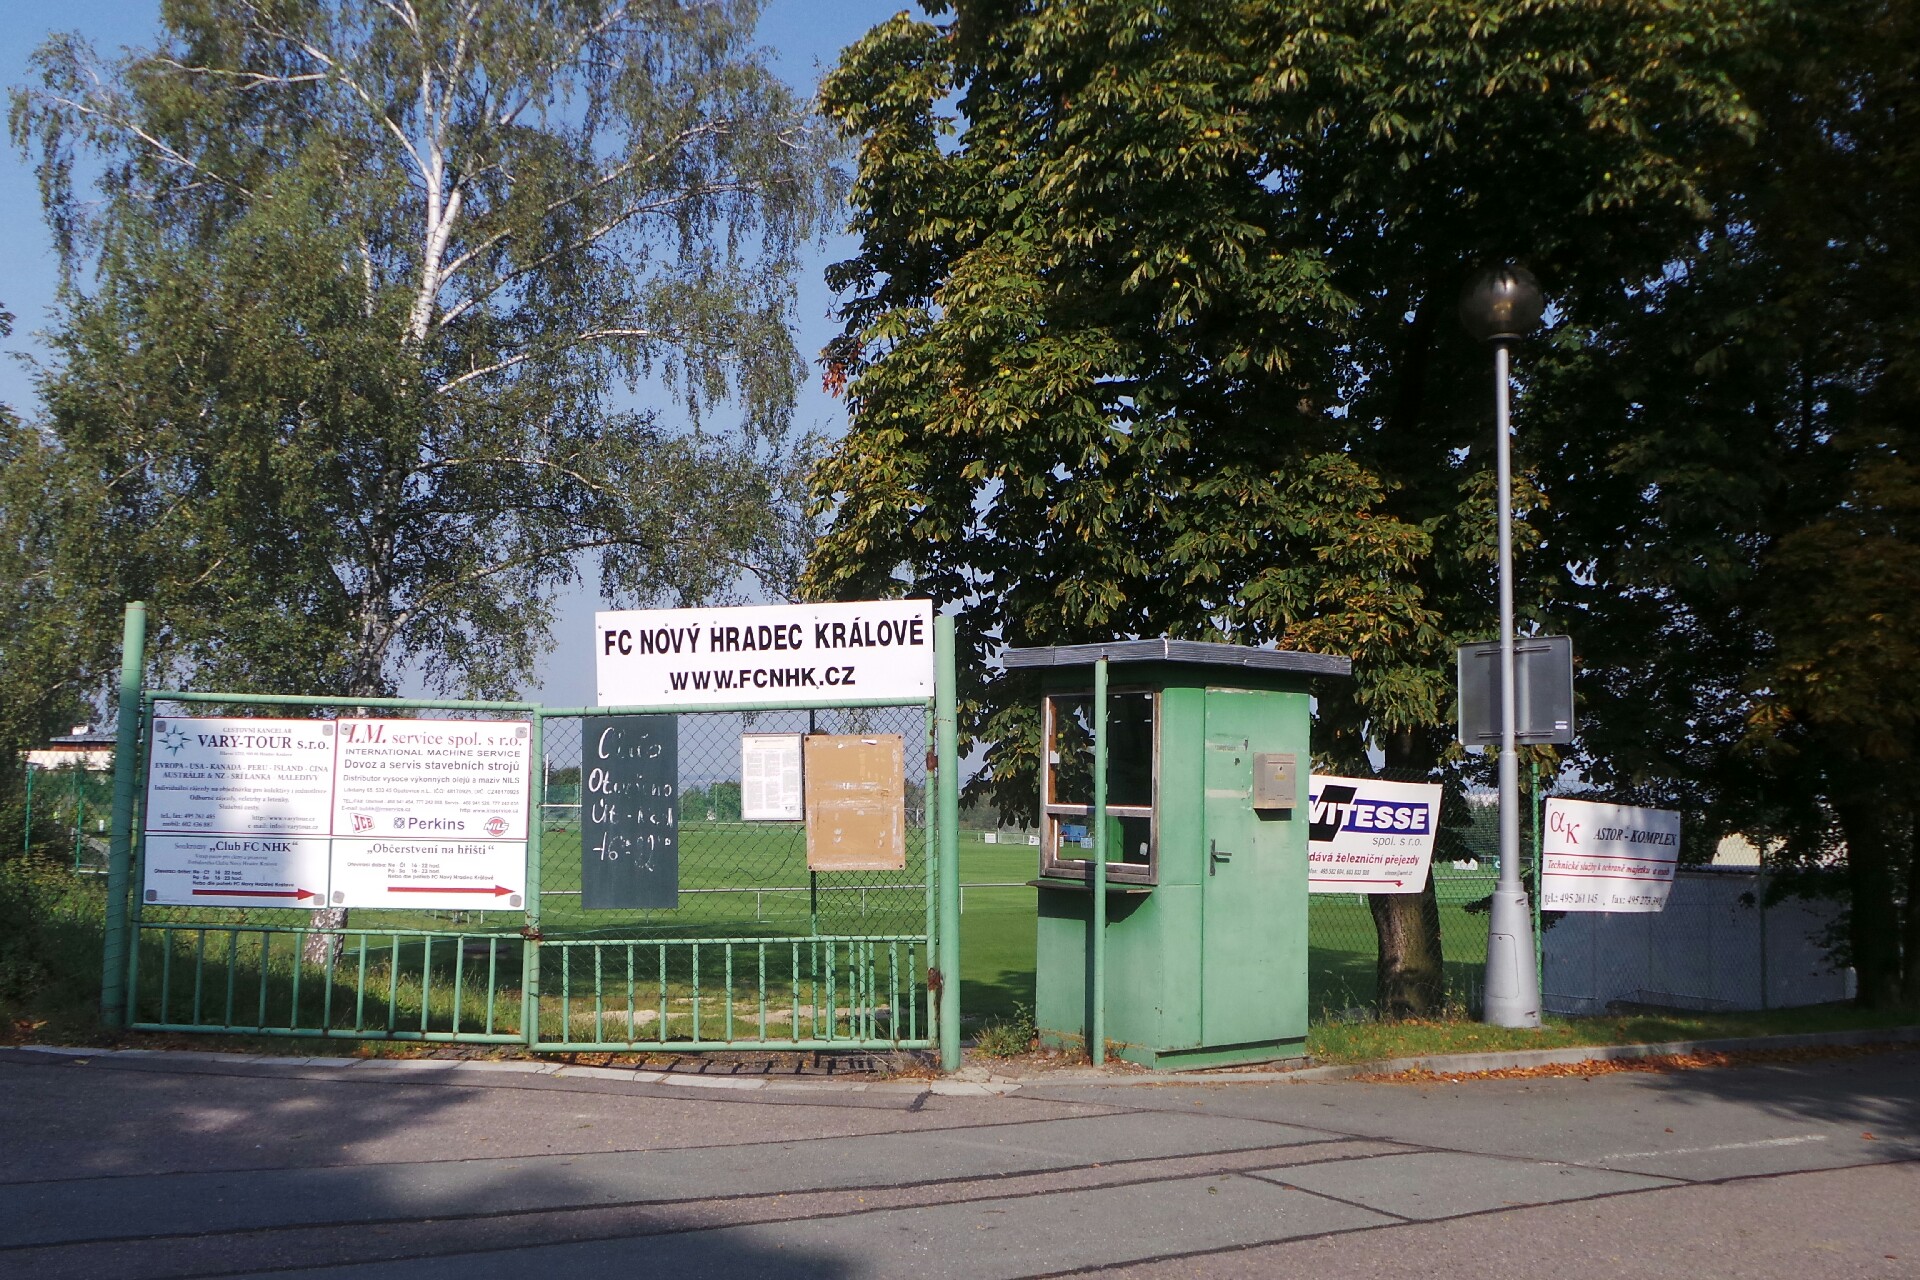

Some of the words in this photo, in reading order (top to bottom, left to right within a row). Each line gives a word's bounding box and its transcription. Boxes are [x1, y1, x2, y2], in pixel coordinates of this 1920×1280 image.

[604, 630, 632, 655] FC
[640, 622, 700, 654] NOVÝ
[710, 624, 803, 652] HRADEC
[815, 615, 924, 649] KRÁLOVÉ
[670, 667, 856, 691] WWW.FCNHK.CZ
[197, 735, 292, 748] VARY-TOUR
[297, 740, 329, 749] s.r.o.
[392, 732, 443, 744] service
[448, 731, 482, 748] spol.
[487, 736, 494, 746] s
[500, 735, 522, 746] r.o.
[346, 748, 423, 756] INTERNATIONAL
[427, 749, 473, 757] MACHINE
[477, 750, 520, 758] SERVICE
[344, 759, 377, 768] Dovoz
[389, 760, 421, 769] servis
[425, 760, 484, 770] stavebních
[487, 760, 520, 773] strojů
[343, 774, 381, 782] Distributor
[353, 814, 373, 831] JCB
[1309, 801, 1428, 830] VITESSE
[408, 818, 465, 830] Perkins
[1372, 837, 1396, 847] spol.
[1593, 828, 1623, 841] ASTOR
[1630, 830, 1677, 846] KOMPLEX
[243, 842, 260, 852] FC
[441, 845, 454, 854] na
[1335, 852, 1384, 864] železniční
[1385, 854, 1420, 866] přejezdy
[1548, 860, 1580, 870] Technické
[1560, 893, 1573, 904] 495
[1611, 894, 1625, 904] fax:
